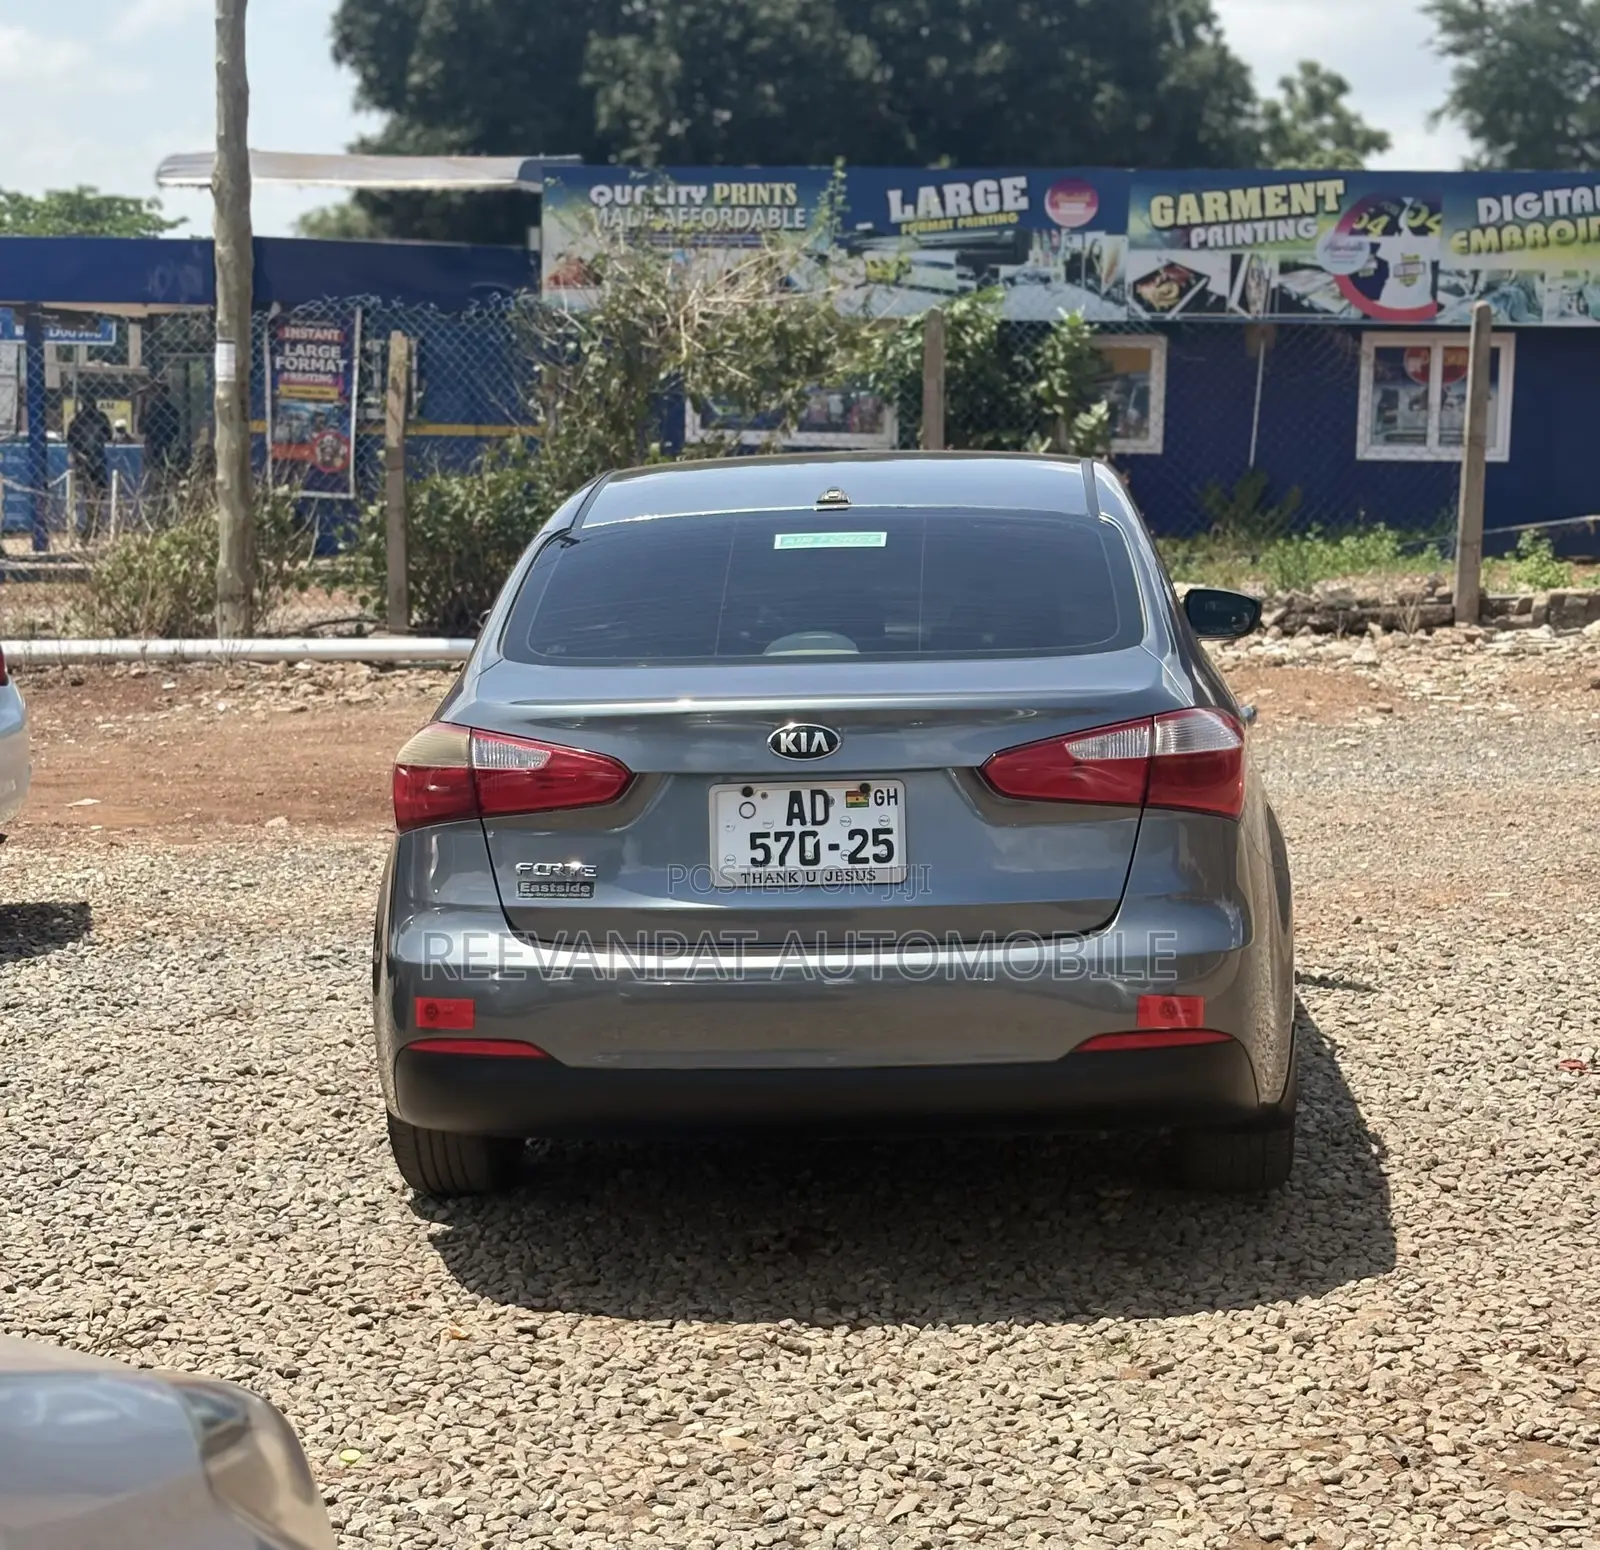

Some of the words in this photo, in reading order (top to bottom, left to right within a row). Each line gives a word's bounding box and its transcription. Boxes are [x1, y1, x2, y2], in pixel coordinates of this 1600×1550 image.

[713, 182, 797, 206] PRINTS
[887, 175, 1029, 223] LARGE
[1151, 179, 1345, 228] GARMENT
[662, 206, 806, 230] AFFORDABLE
[901, 218, 954, 235] FORMAT
[957, 212, 1019, 229] PRINTING
[1189, 217, 1318, 249] PRINTING
[284, 326, 341, 341] INSTANT
[284, 342, 341, 359] LARGE
[275, 356, 349, 373] FORMAT
[779, 731, 829, 753] KIA
[786, 789, 829, 826] AD
[873, 788, 898, 807] GH
[750, 827, 894, 868] 570-25
[515, 862, 597, 877] FORTE
[741, 872, 798, 884] THANK
[806, 872, 816, 883] U
[824, 870, 876, 882] JESUS
[520, 882, 590, 893] Eastside
